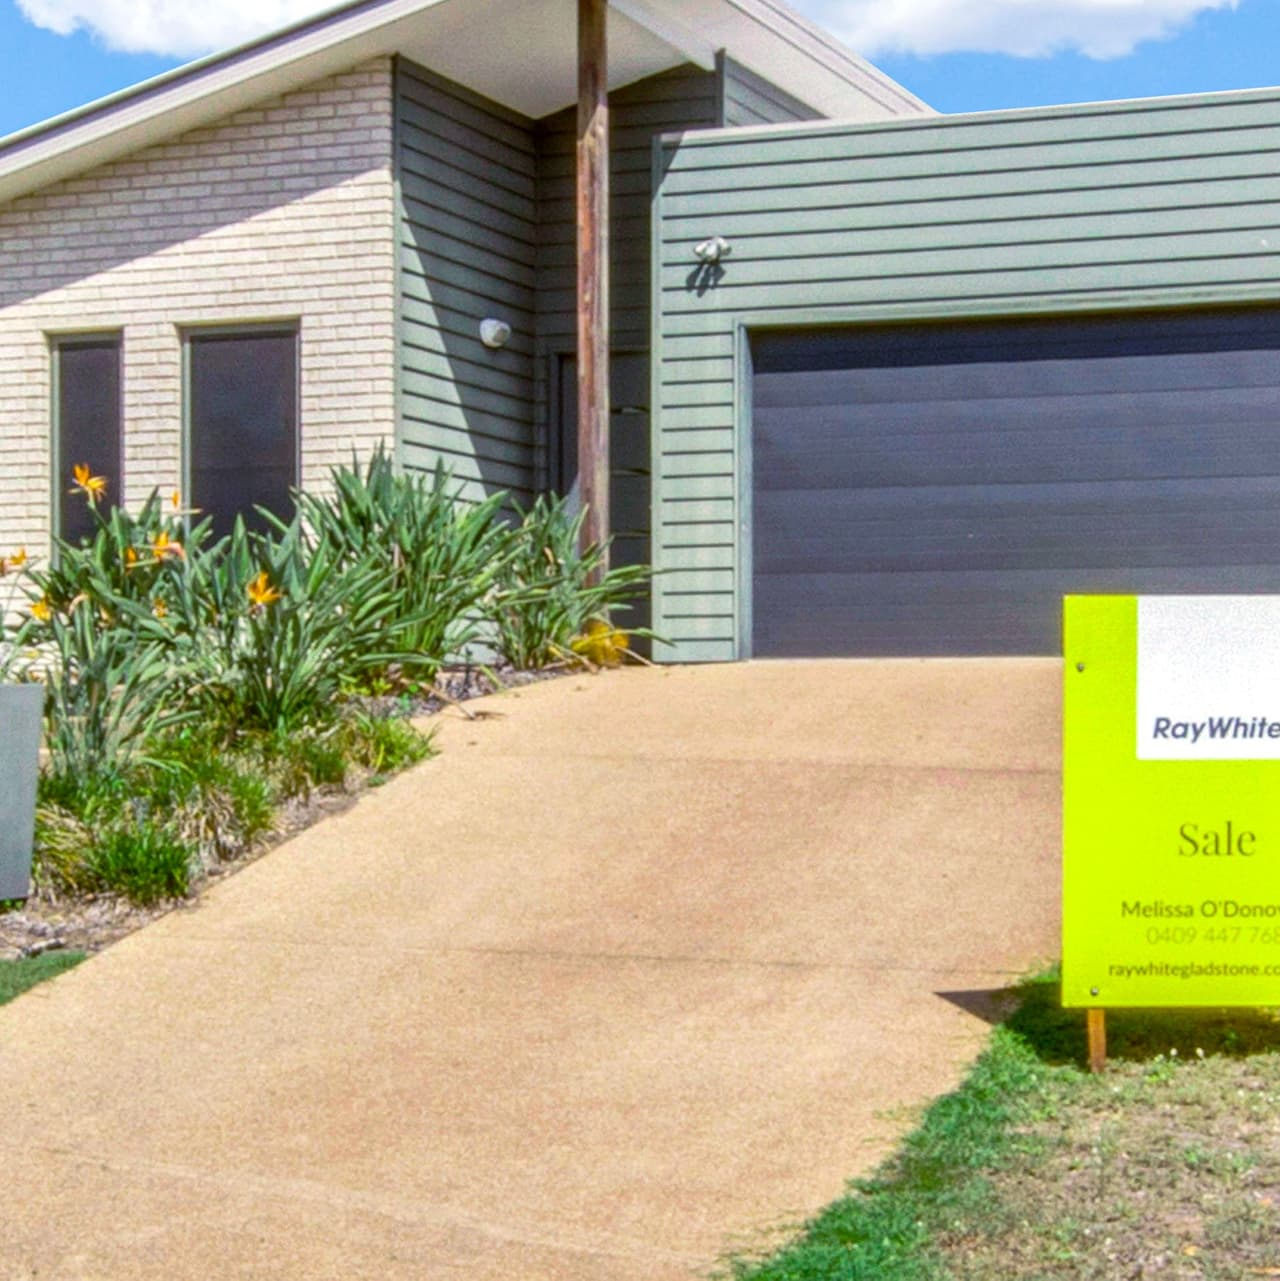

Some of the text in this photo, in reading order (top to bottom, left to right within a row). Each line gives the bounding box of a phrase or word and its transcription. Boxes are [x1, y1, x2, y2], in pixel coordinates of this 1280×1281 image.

[1178, 820, 1257, 857] Sale
[1121, 900, 1194, 918] Melissa
[1146, 926, 1197, 945] 0409
[1203, 926, 1241, 945] 447
